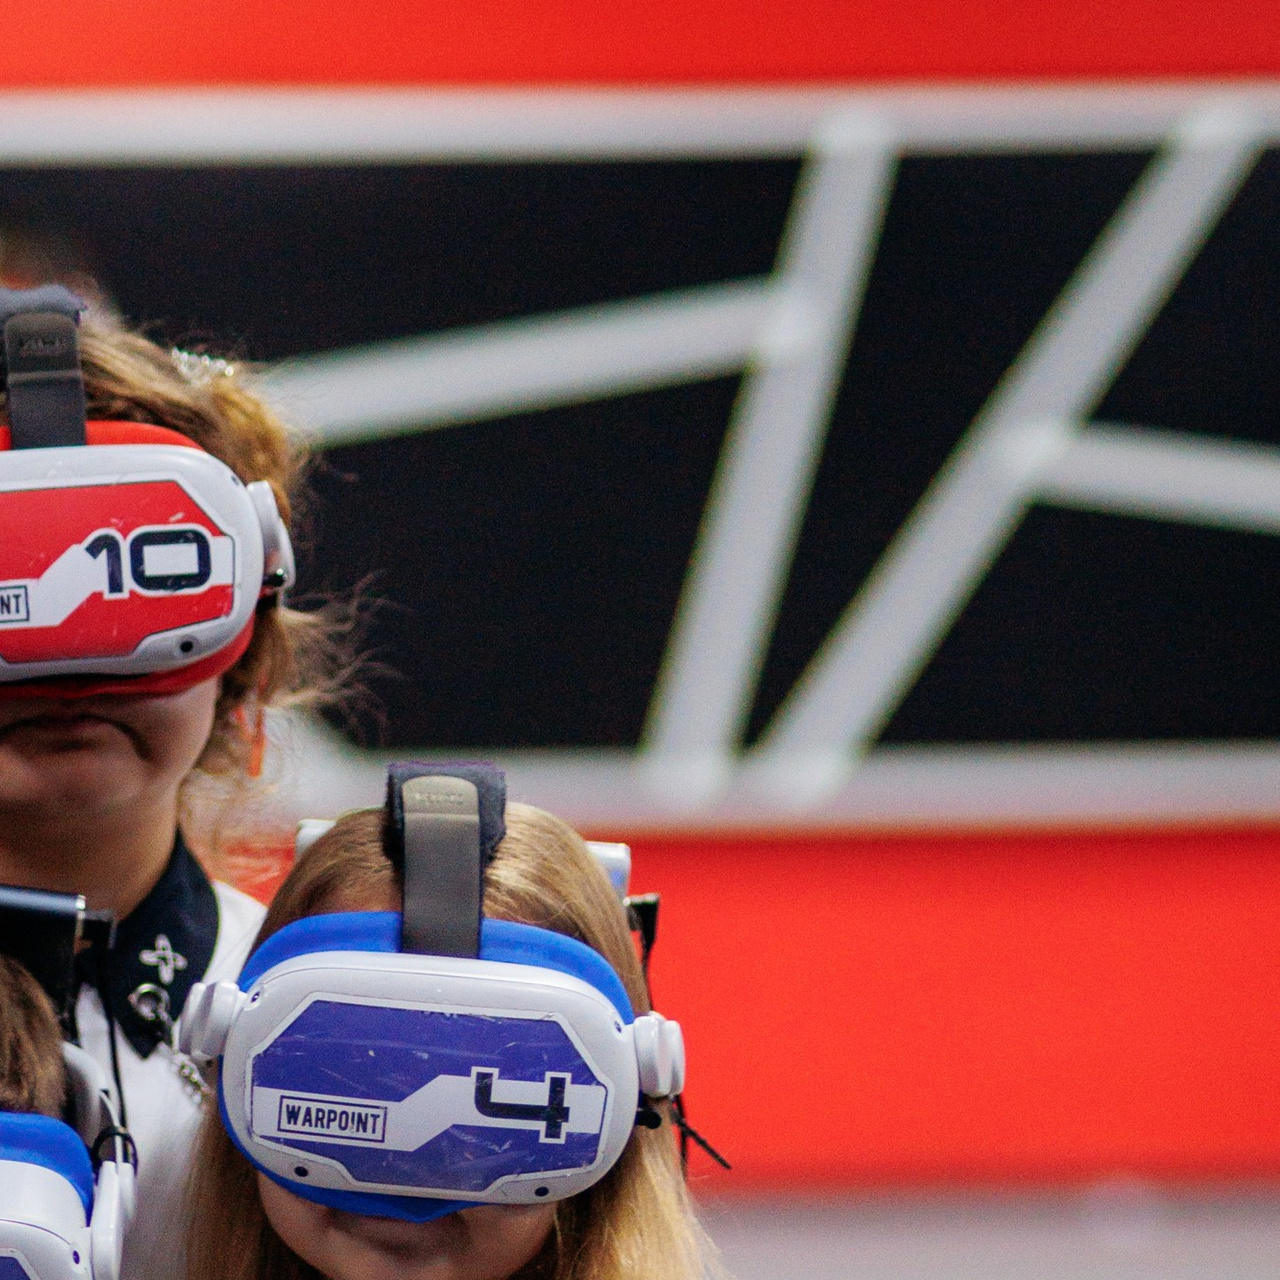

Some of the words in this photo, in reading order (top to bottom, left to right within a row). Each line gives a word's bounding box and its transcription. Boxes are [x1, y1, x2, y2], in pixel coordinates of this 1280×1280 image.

[85, 530, 212, 594] 10
[285, 1104, 381, 1135] WARPOINT
[475, 1072, 570, 1139] 4
